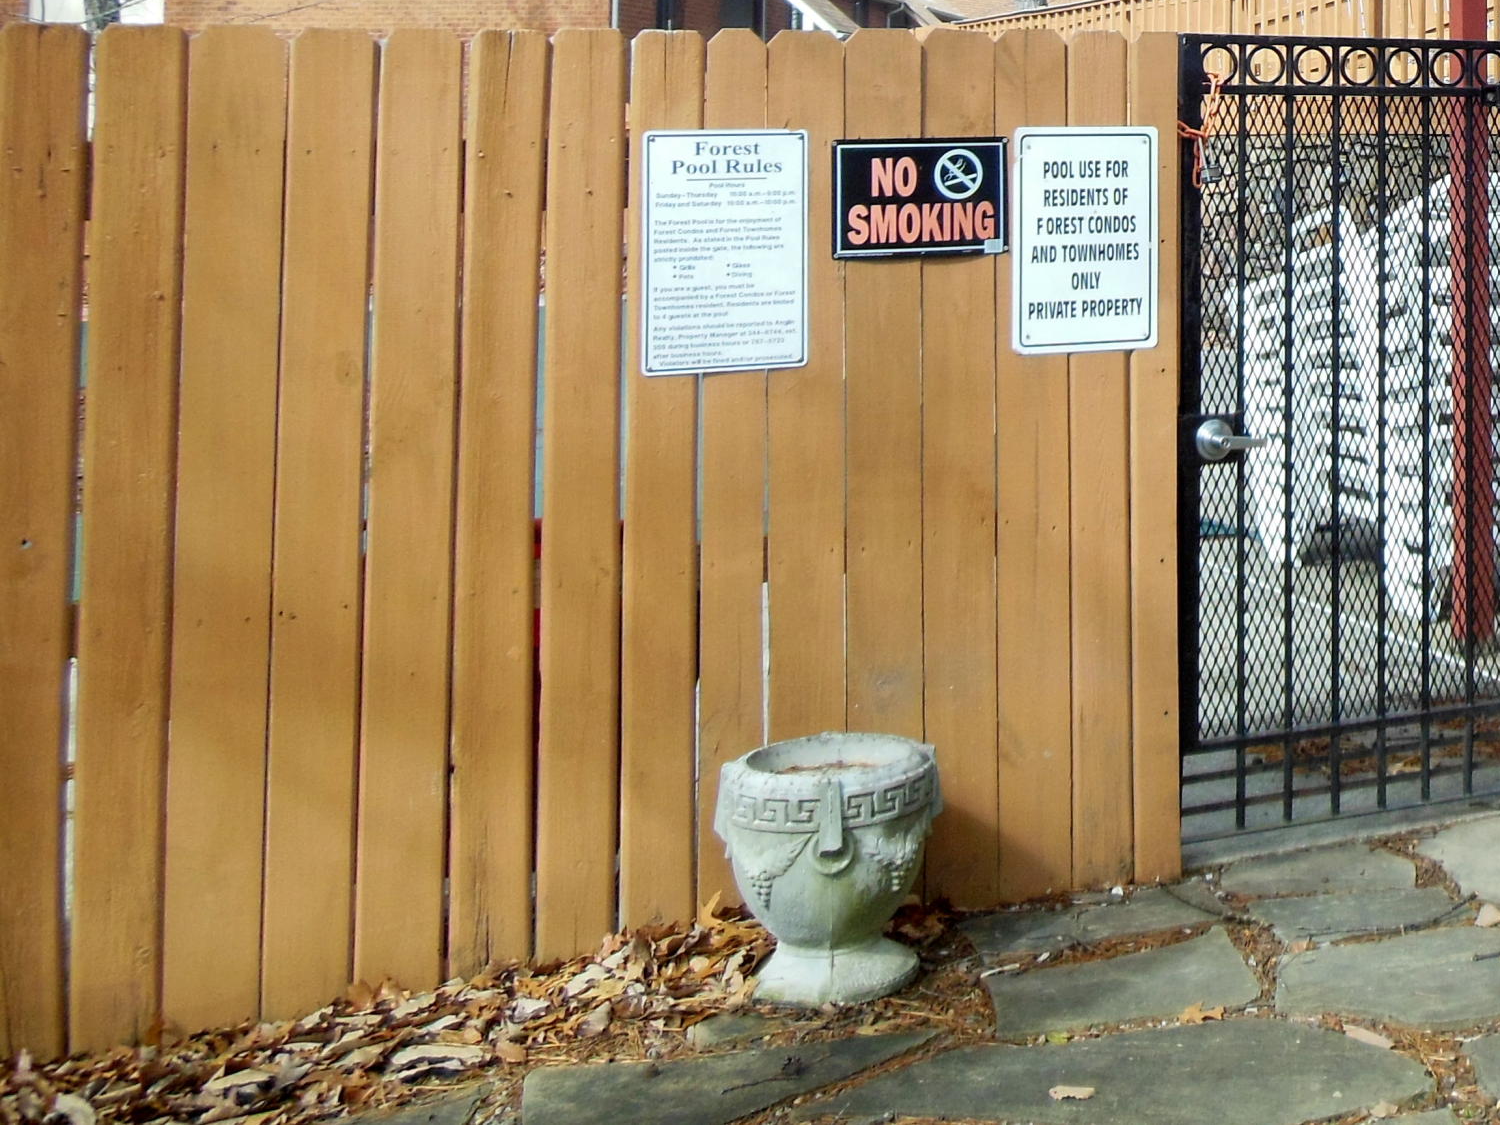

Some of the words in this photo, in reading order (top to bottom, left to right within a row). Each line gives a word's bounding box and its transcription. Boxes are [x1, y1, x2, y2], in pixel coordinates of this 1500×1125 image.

[694, 141, 761, 156] Forest
[671, 159, 717, 175] Pool
[726, 159, 783, 174] Rules
[871, 156, 918, 197] NO
[1043, 161, 1074, 179] POOL
[1079, 161, 1101, 178] USE
[1106, 160, 1128, 178] FOR
[1043, 188, 1109, 207] RESIDENTS
[1114, 187, 1128, 206] OF
[847, 201, 995, 245] SMOKING
[1087, 215, 1136, 234] CONDOS
[1031, 245, 1057, 263] AND
[1062, 243, 1140, 263] TOWNHOMES
[1071, 271, 1102, 290] ONLY
[1028, 301, 1077, 320] PRIVATE
[1081, 297, 1143, 317] PROPERTY
